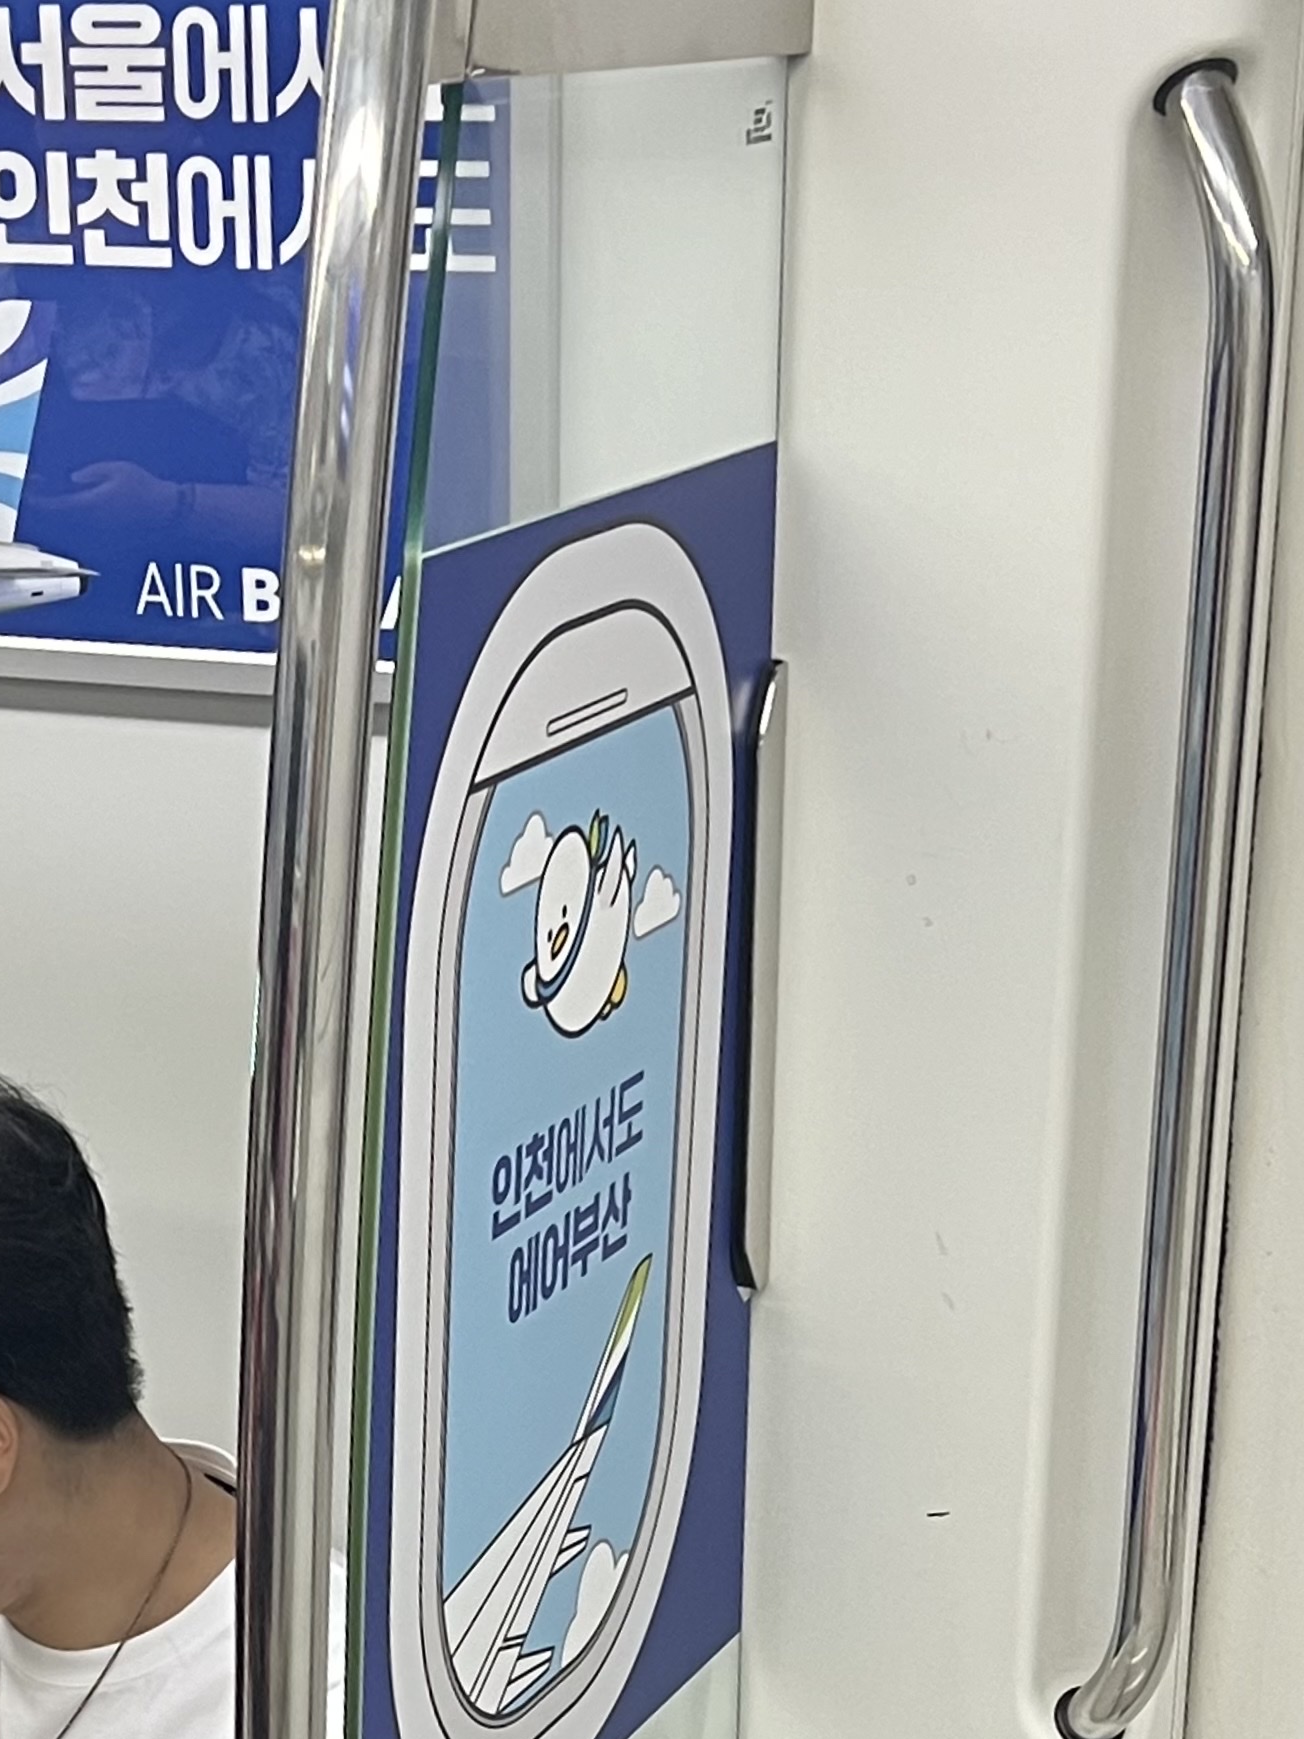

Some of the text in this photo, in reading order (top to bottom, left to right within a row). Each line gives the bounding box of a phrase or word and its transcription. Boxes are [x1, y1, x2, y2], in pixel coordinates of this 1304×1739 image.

[136, 561, 225, 621] AIR
[492, 1069, 645, 1241] 인천에서도
[508, 1171, 632, 1324] 에어부산
